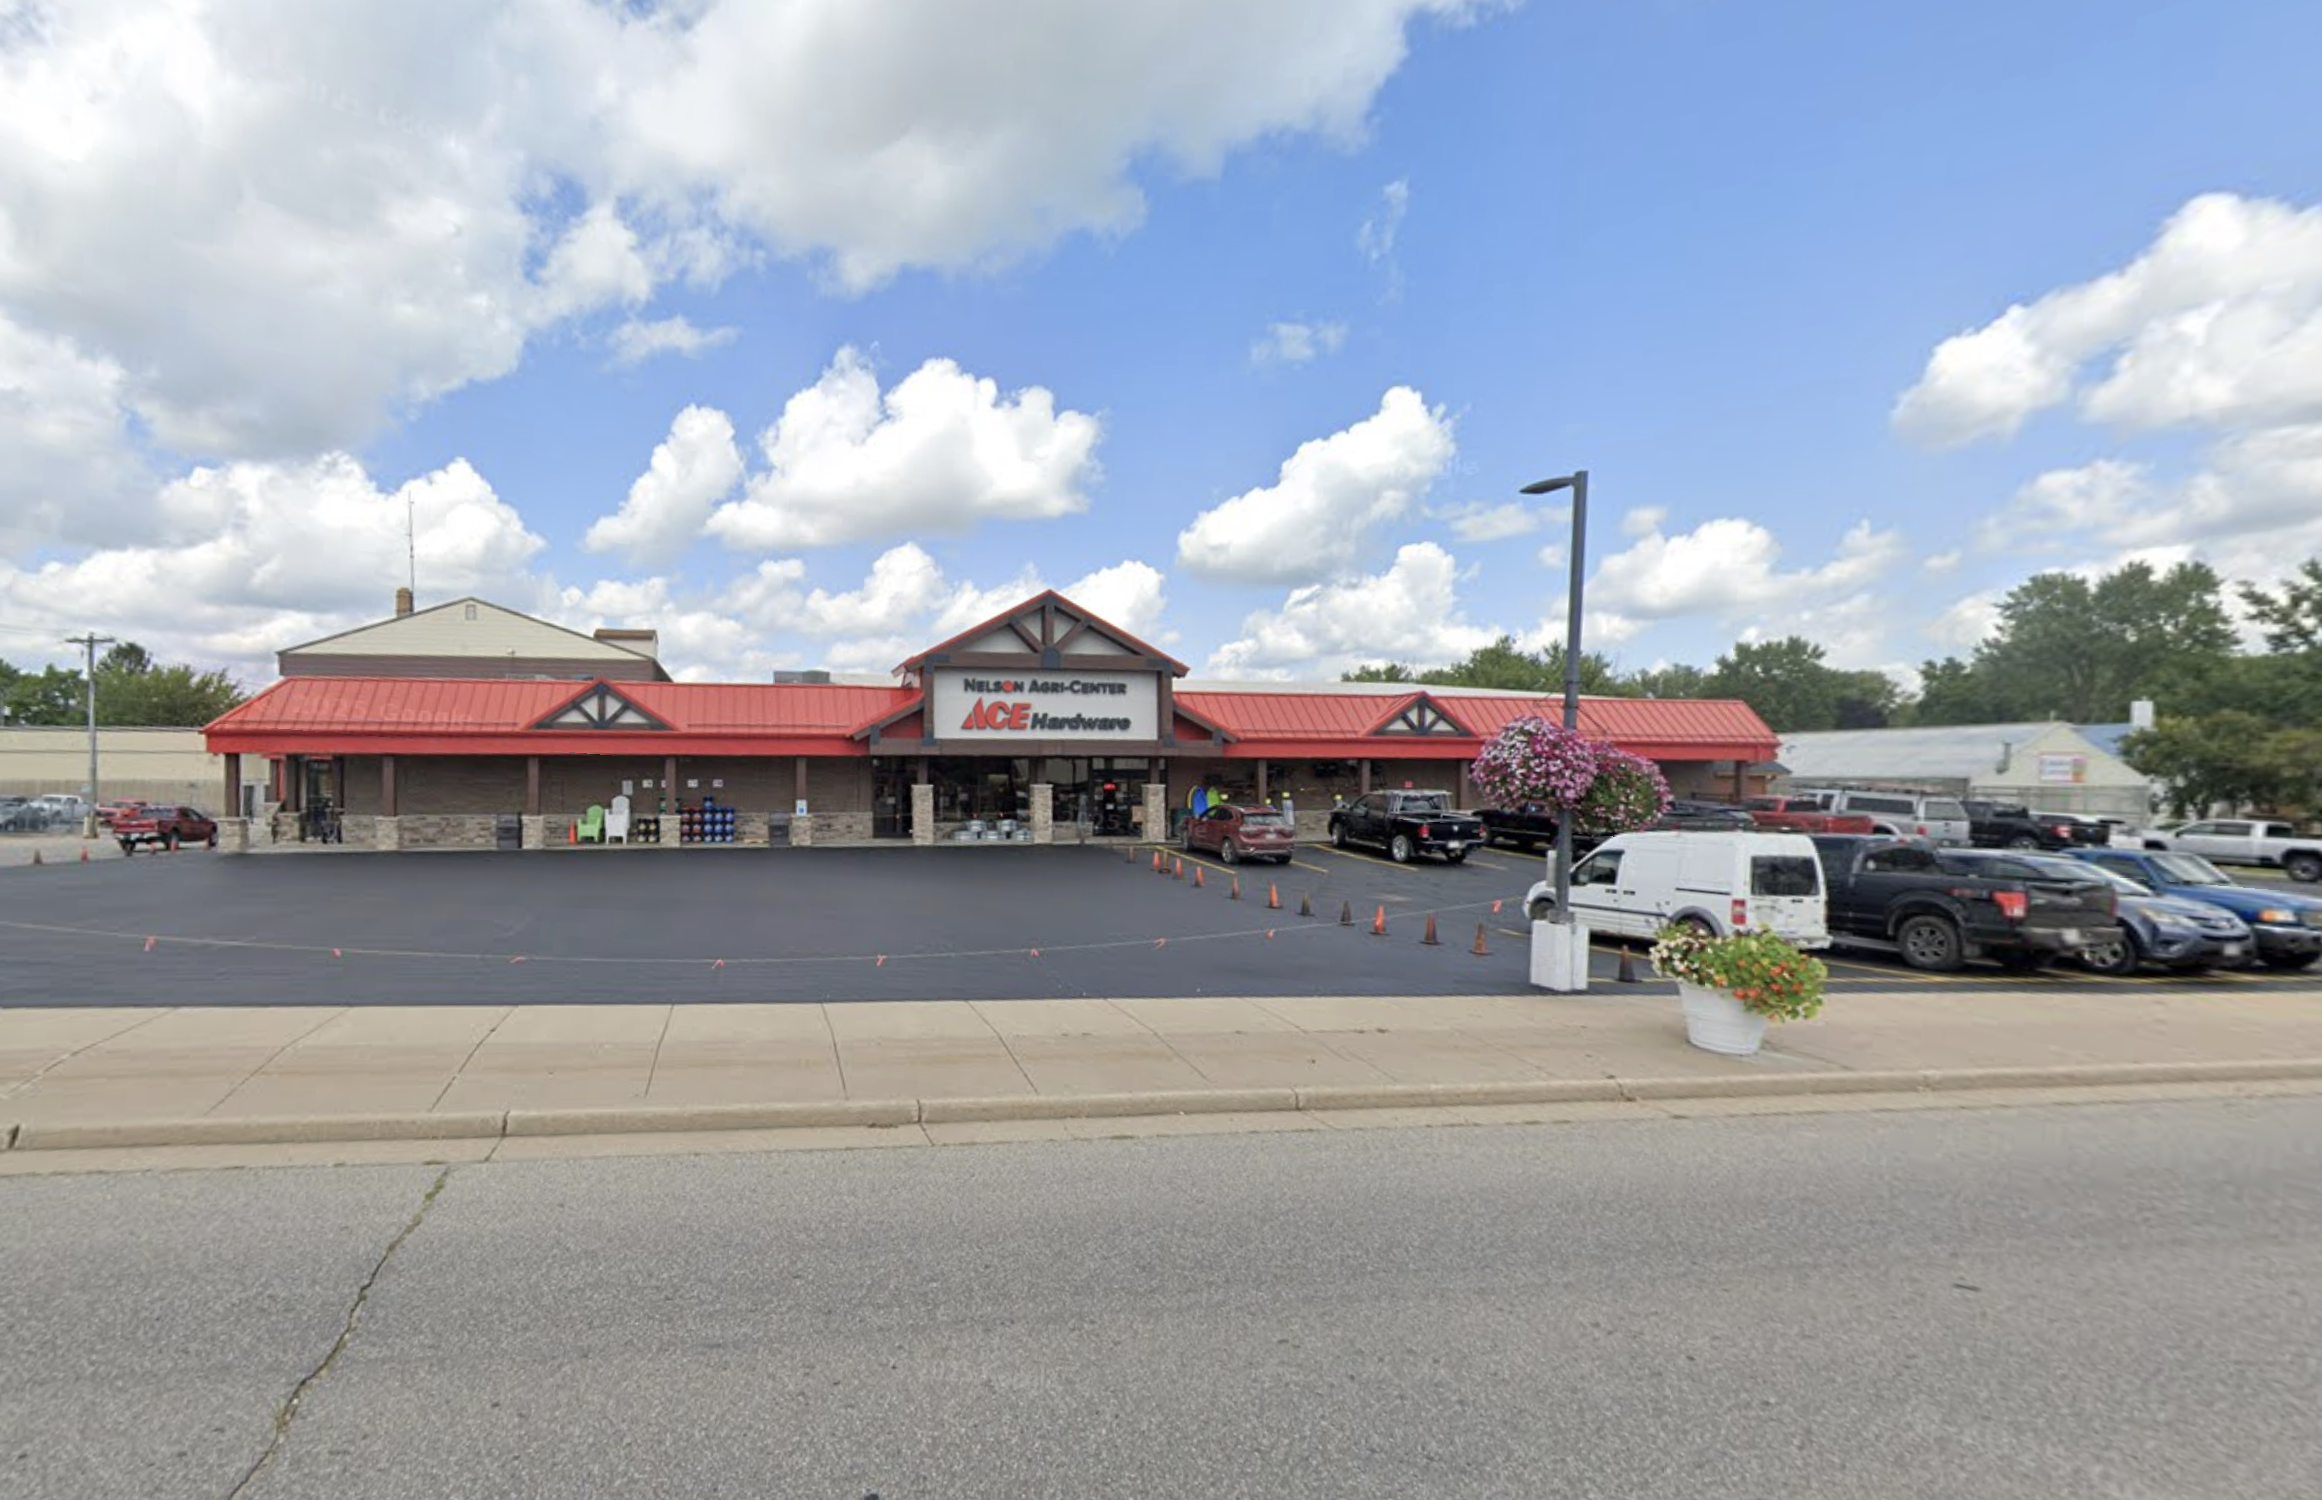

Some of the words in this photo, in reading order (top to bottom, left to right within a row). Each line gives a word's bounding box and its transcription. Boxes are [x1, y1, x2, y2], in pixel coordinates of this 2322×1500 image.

[963, 678, 1024, 693] NELSON
[1028, 679, 1127, 695] AGRI-CENTER
[962, 697, 1031, 730] ACE
[1031, 713, 1131, 731] Hardware
